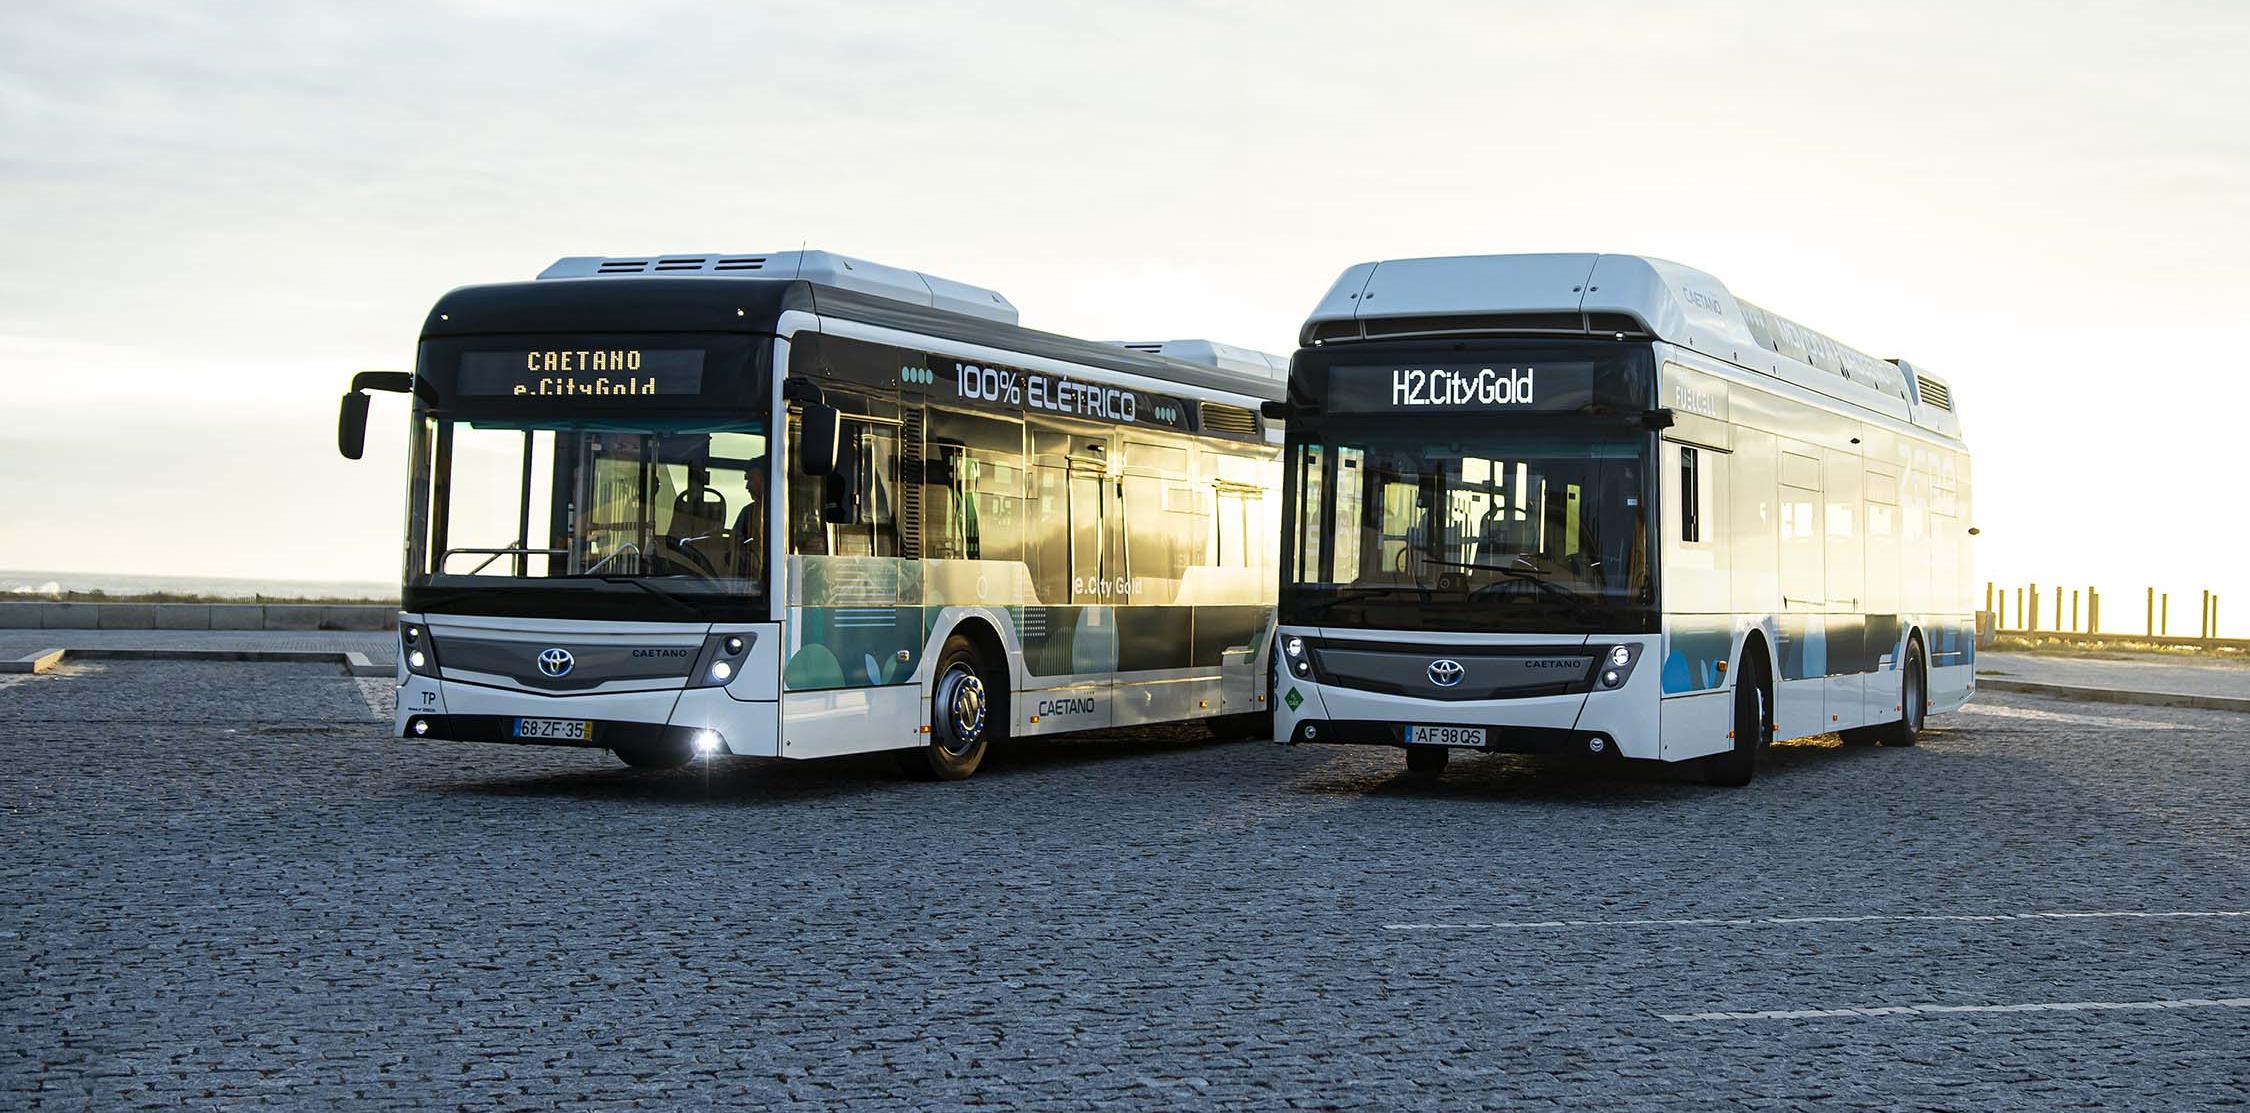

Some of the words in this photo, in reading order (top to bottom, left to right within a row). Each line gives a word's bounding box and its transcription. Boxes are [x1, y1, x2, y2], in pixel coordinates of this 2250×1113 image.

[1682, 287, 1722, 315] CAETANO
[527, 350, 641, 371] CAETANO
[514, 377, 656, 396] e.CityGold
[956, 363, 1020, 405] 100%
[1027, 375, 1136, 422] ELÉTRICO
[1393, 368, 1533, 405] H2.CityGold
[632, 648, 687, 658] CAETANO
[1525, 660, 1581, 669] CAETANO
[421, 691, 436, 705] TP
[1039, 698, 1095, 717] CAETANO
[1417, 728, 1439, 742] AF
[1441, 729, 1458, 743] 98
[1461, 729, 1481, 744] QS
